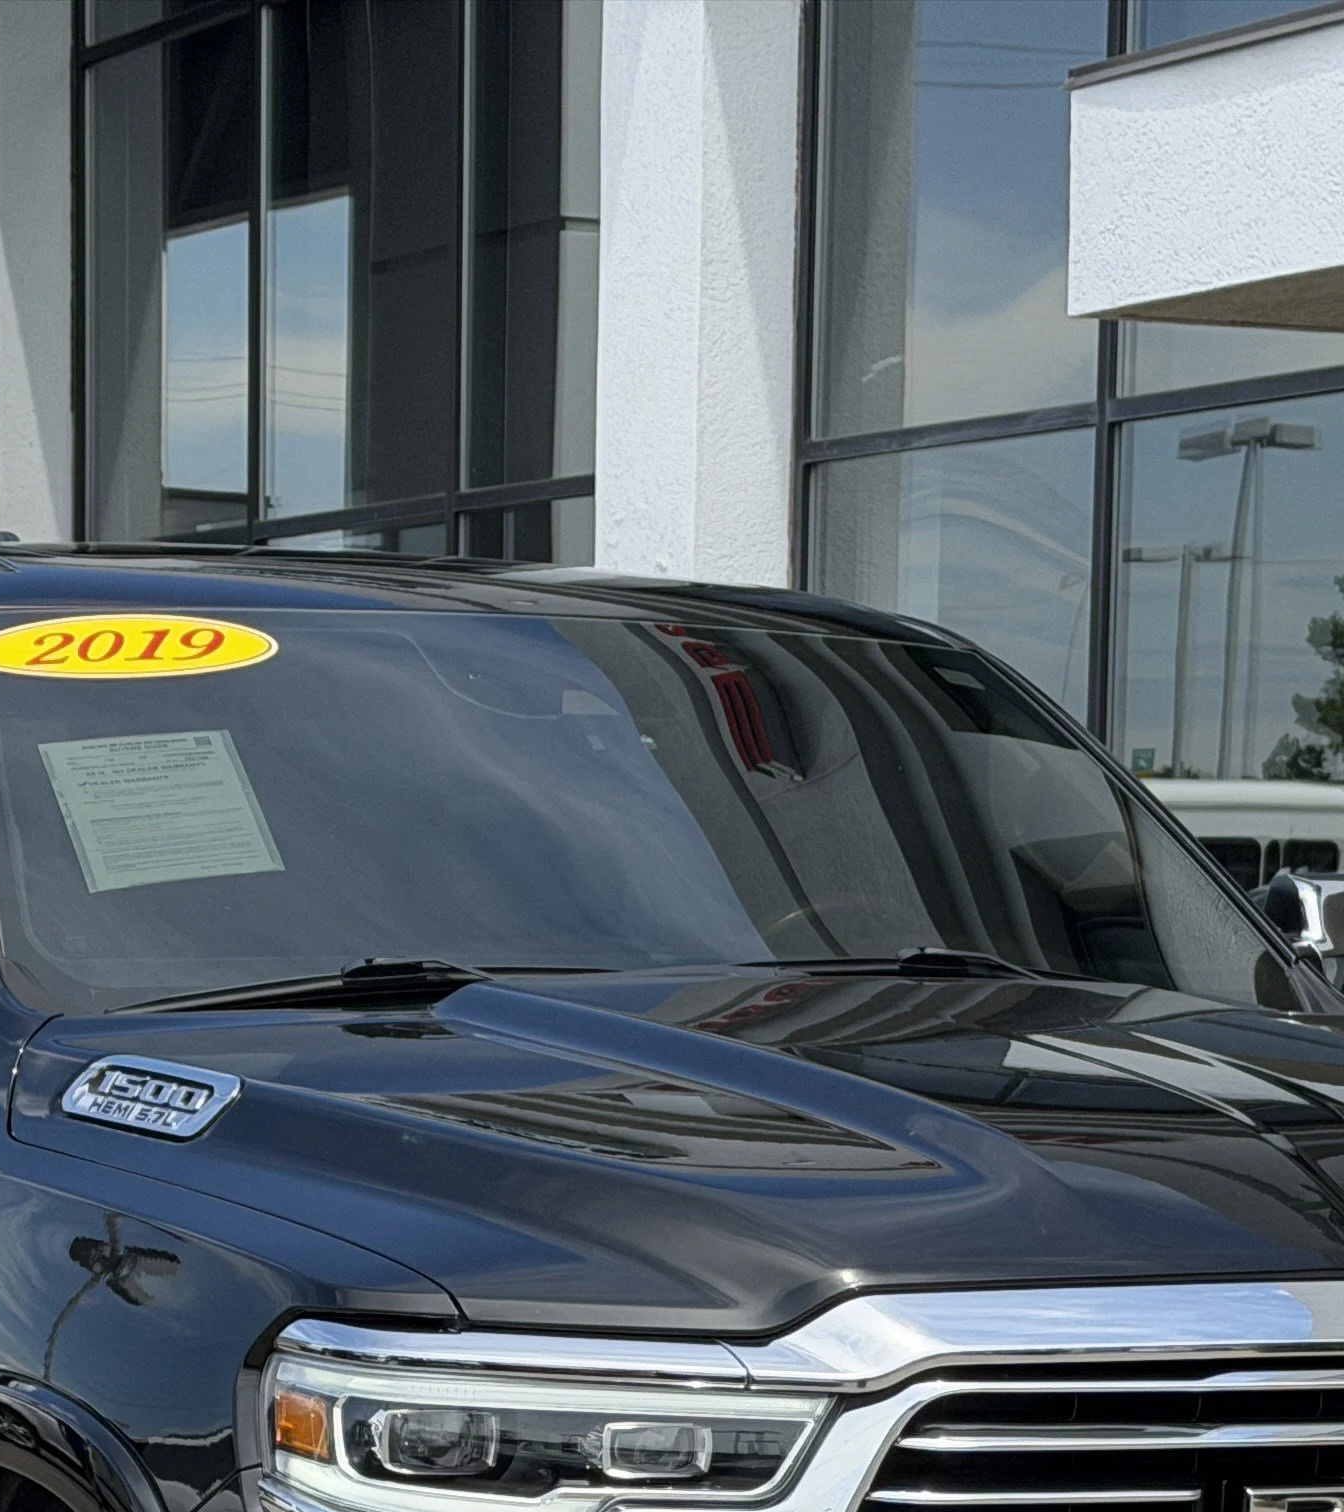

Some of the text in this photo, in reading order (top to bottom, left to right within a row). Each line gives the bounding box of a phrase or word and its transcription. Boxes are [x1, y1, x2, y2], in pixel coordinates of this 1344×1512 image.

[25, 628, 225, 665] 2019
[98, 1070, 210, 1109] 1500
[88, 1097, 177, 1127] HEMI 5.7L
